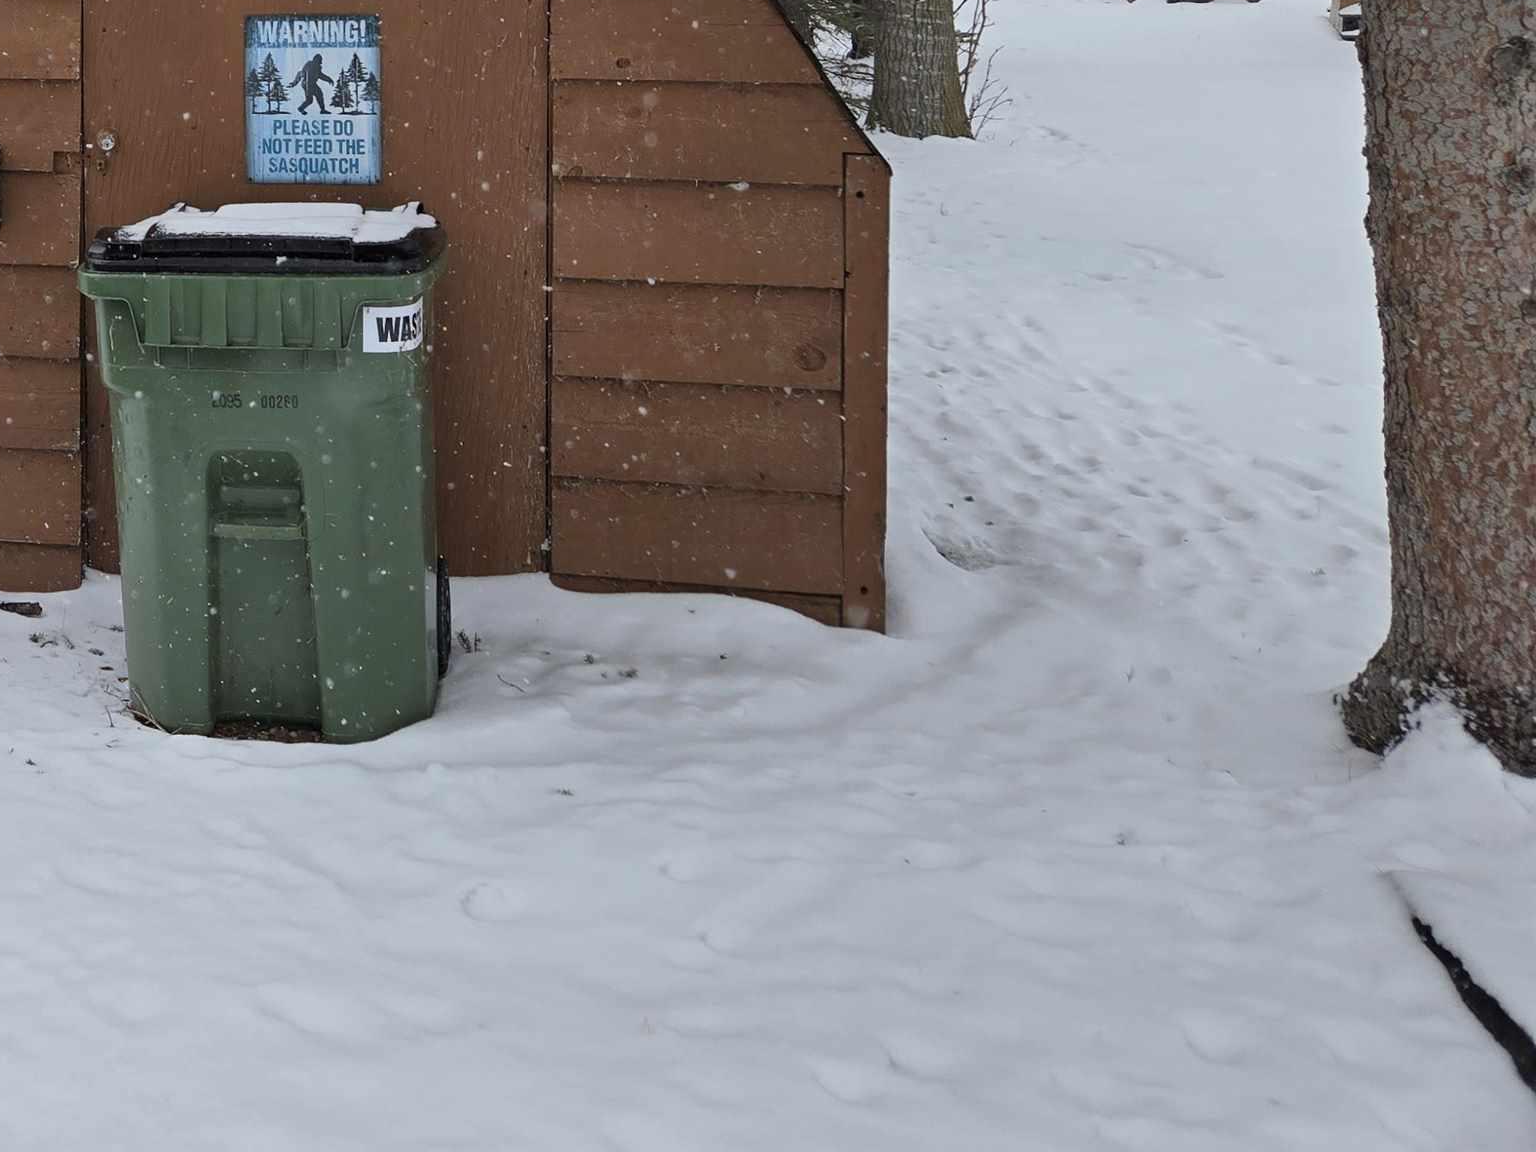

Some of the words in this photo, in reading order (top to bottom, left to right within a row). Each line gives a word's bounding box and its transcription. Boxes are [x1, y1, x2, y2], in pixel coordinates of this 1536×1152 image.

[257, 19, 366, 44] WARNING!
[273, 119, 330, 136] PLEASE
[333, 119, 354, 137] DO
[262, 138, 292, 155] NOT
[295, 138, 332, 155] FEED
[336, 138, 366, 155] THE
[268, 157, 360, 175] SASQUATCH
